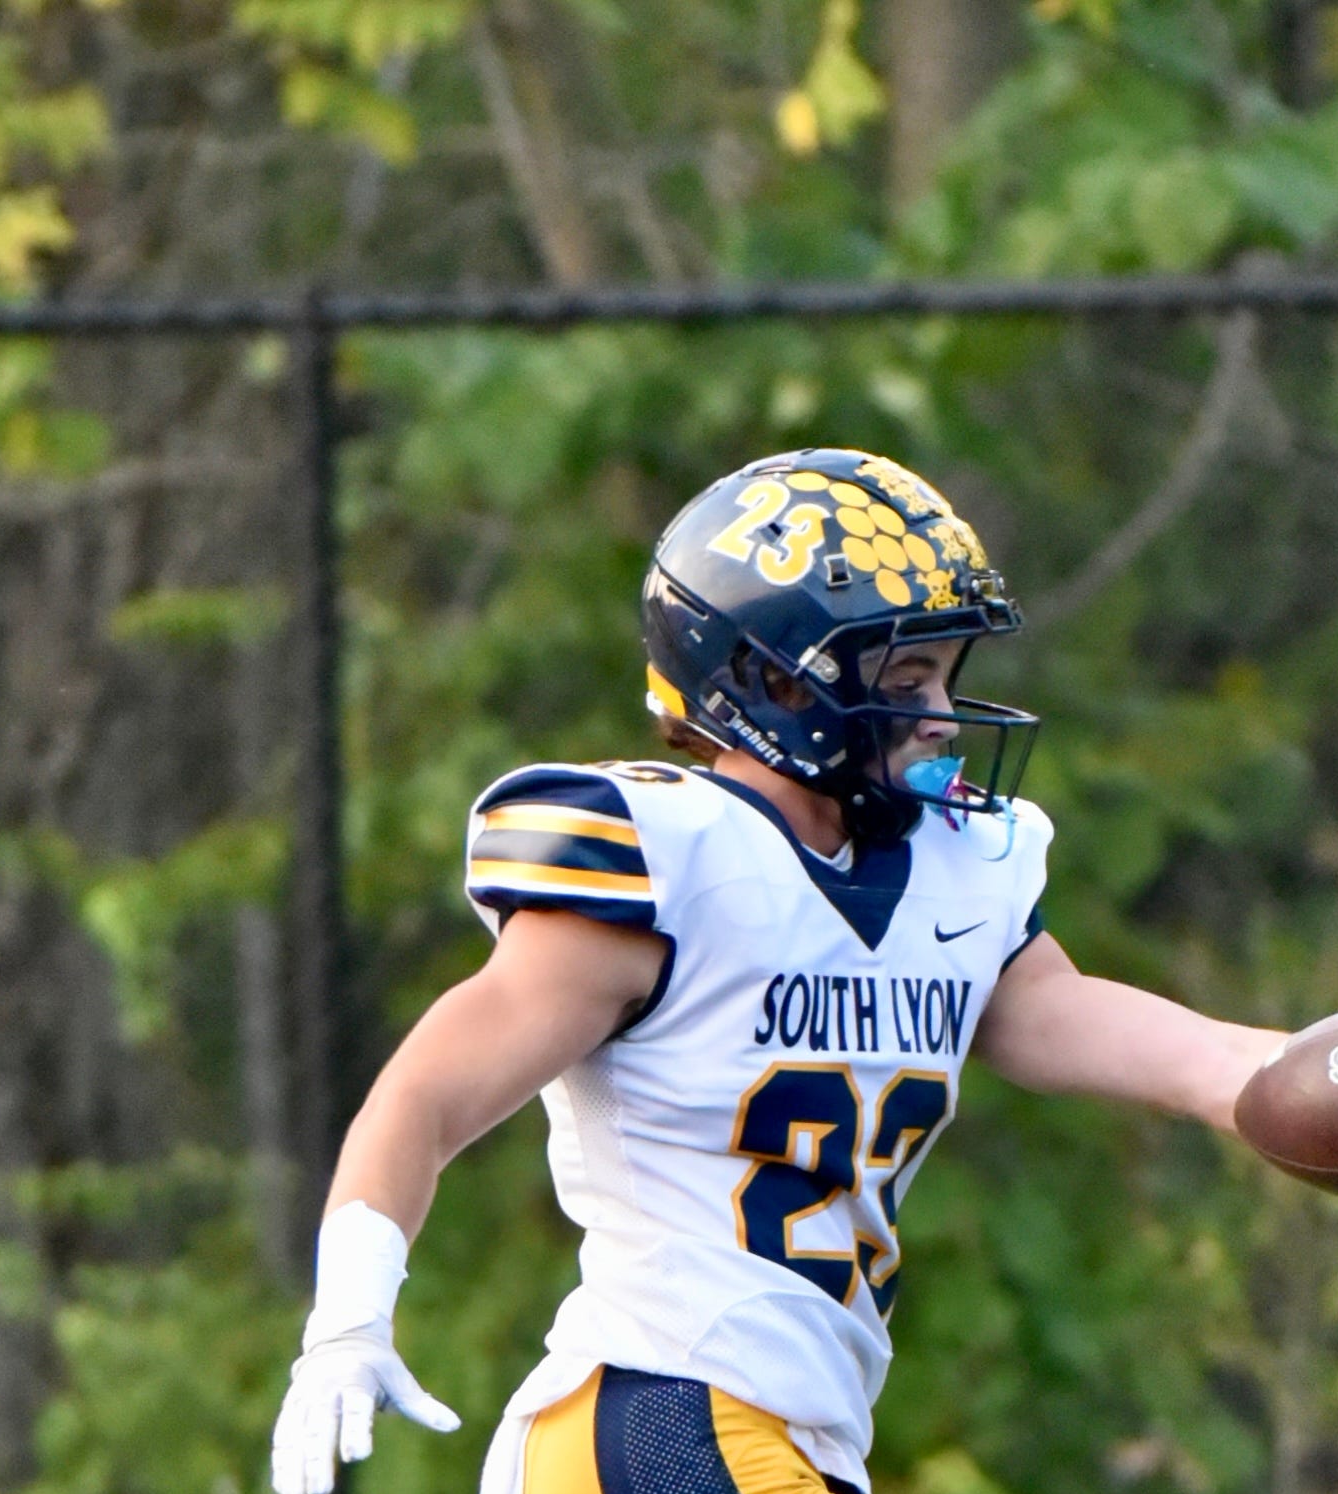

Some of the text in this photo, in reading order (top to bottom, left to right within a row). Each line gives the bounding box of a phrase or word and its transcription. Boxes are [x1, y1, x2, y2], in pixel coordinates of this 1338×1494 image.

[706, 480, 831, 586] 23
[755, 972, 973, 1056] SOUTH LYON
